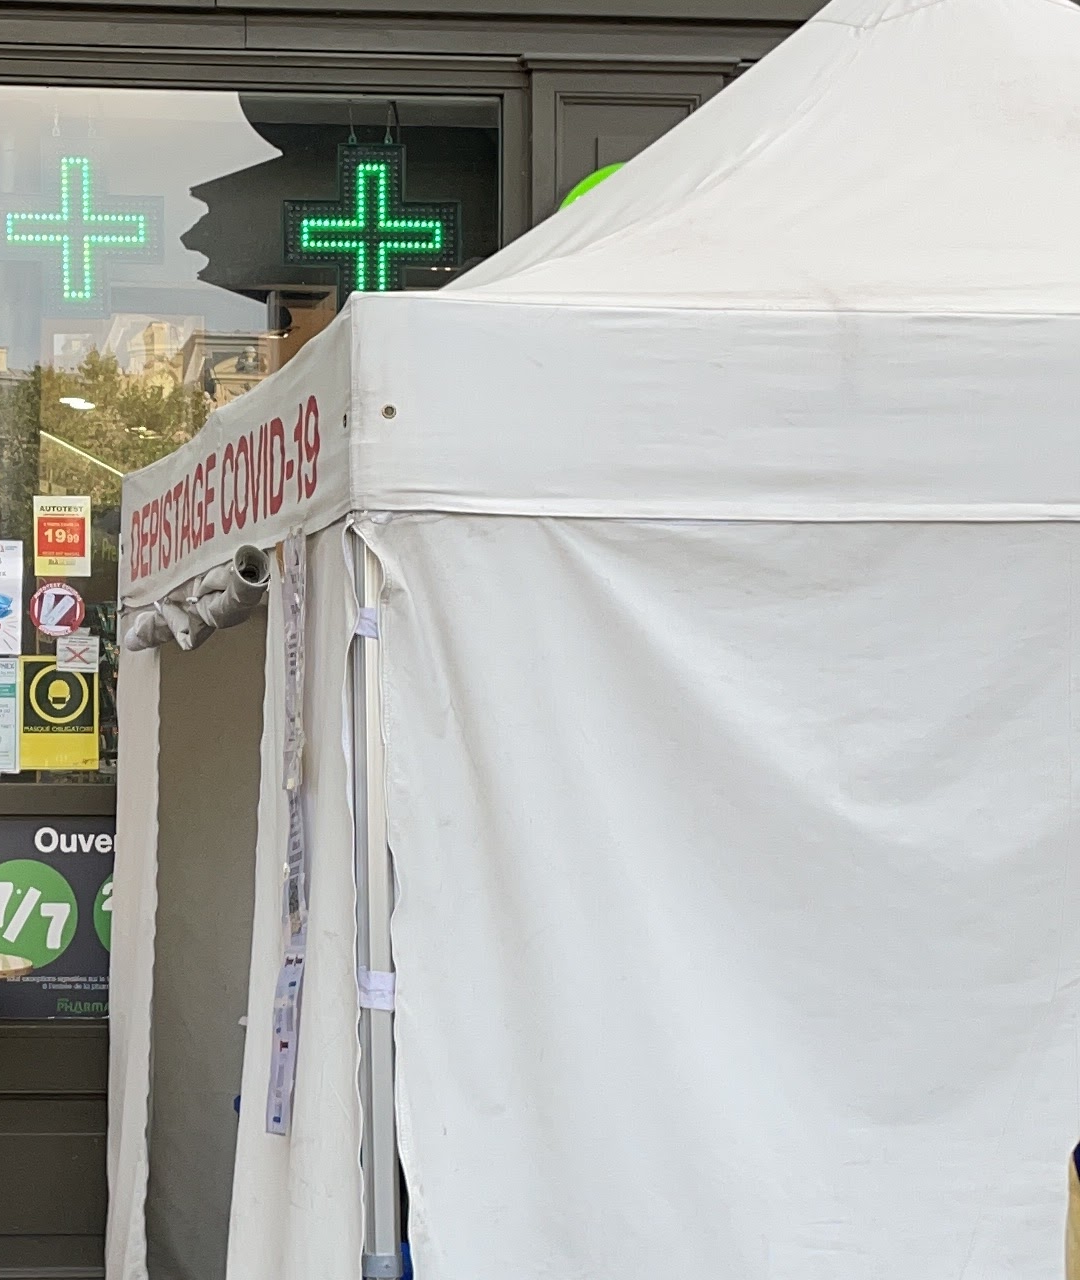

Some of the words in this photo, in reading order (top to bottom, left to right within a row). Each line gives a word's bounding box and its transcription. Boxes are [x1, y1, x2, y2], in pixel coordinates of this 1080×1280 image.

[39, 505, 84, 513] AUTOTEST
[130, 452, 217, 583] DEPISTAGE
[220, 394, 321, 536] COVID-19
